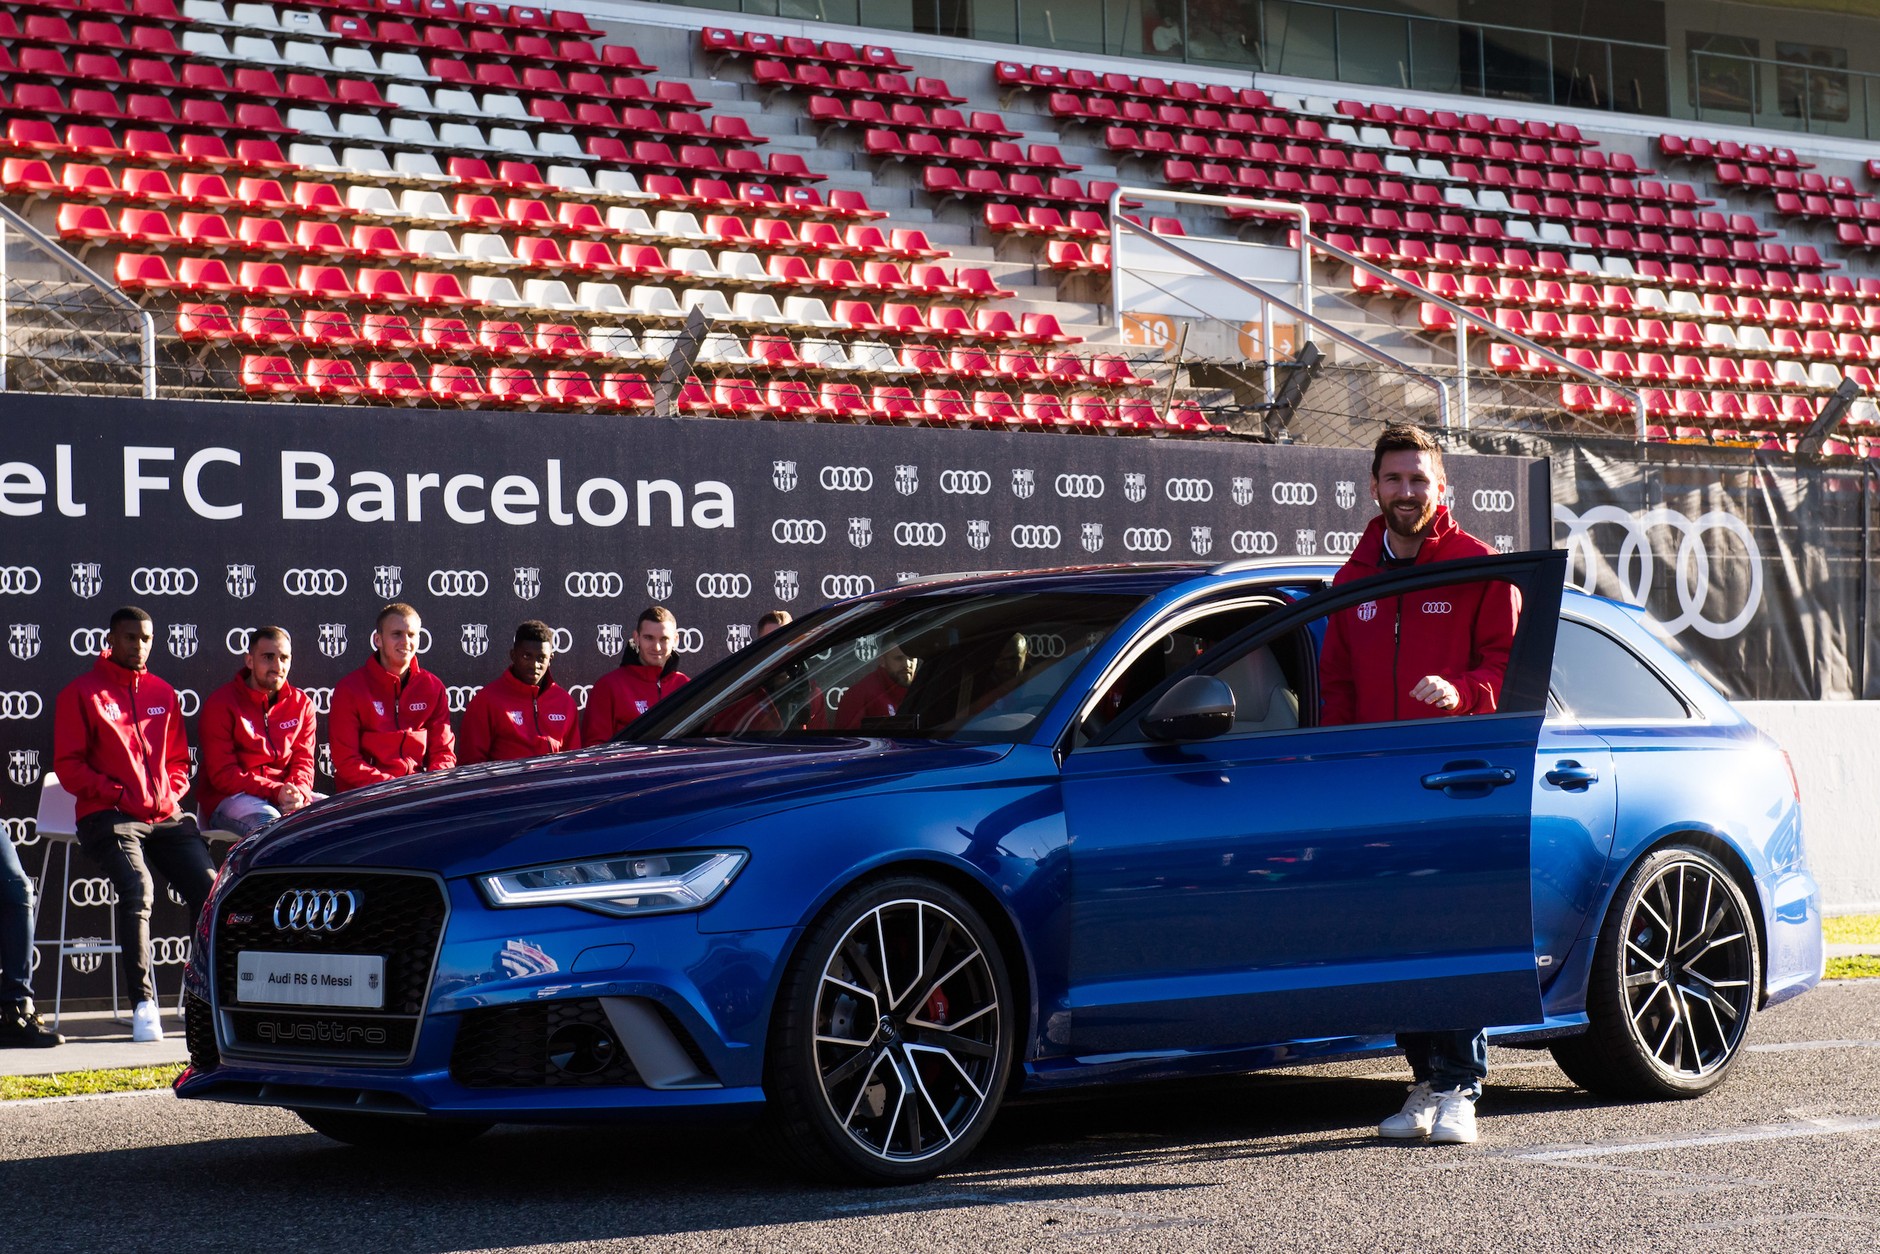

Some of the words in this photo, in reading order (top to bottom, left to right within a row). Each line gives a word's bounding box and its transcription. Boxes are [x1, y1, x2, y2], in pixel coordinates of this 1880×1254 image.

[1139, 320, 1169, 346] 10
[1248, 328, 1260, 353] 1
[0, 444, 87, 518] el
[123, 446, 243, 520] FC
[280, 450, 735, 528] Barcelona
[267, 972, 291, 985] Audi
[293, 973, 308, 985] RS
[310, 974, 318, 986] 6
[320, 974, 352, 987] Messi
[257, 1020, 387, 1044] quattro
